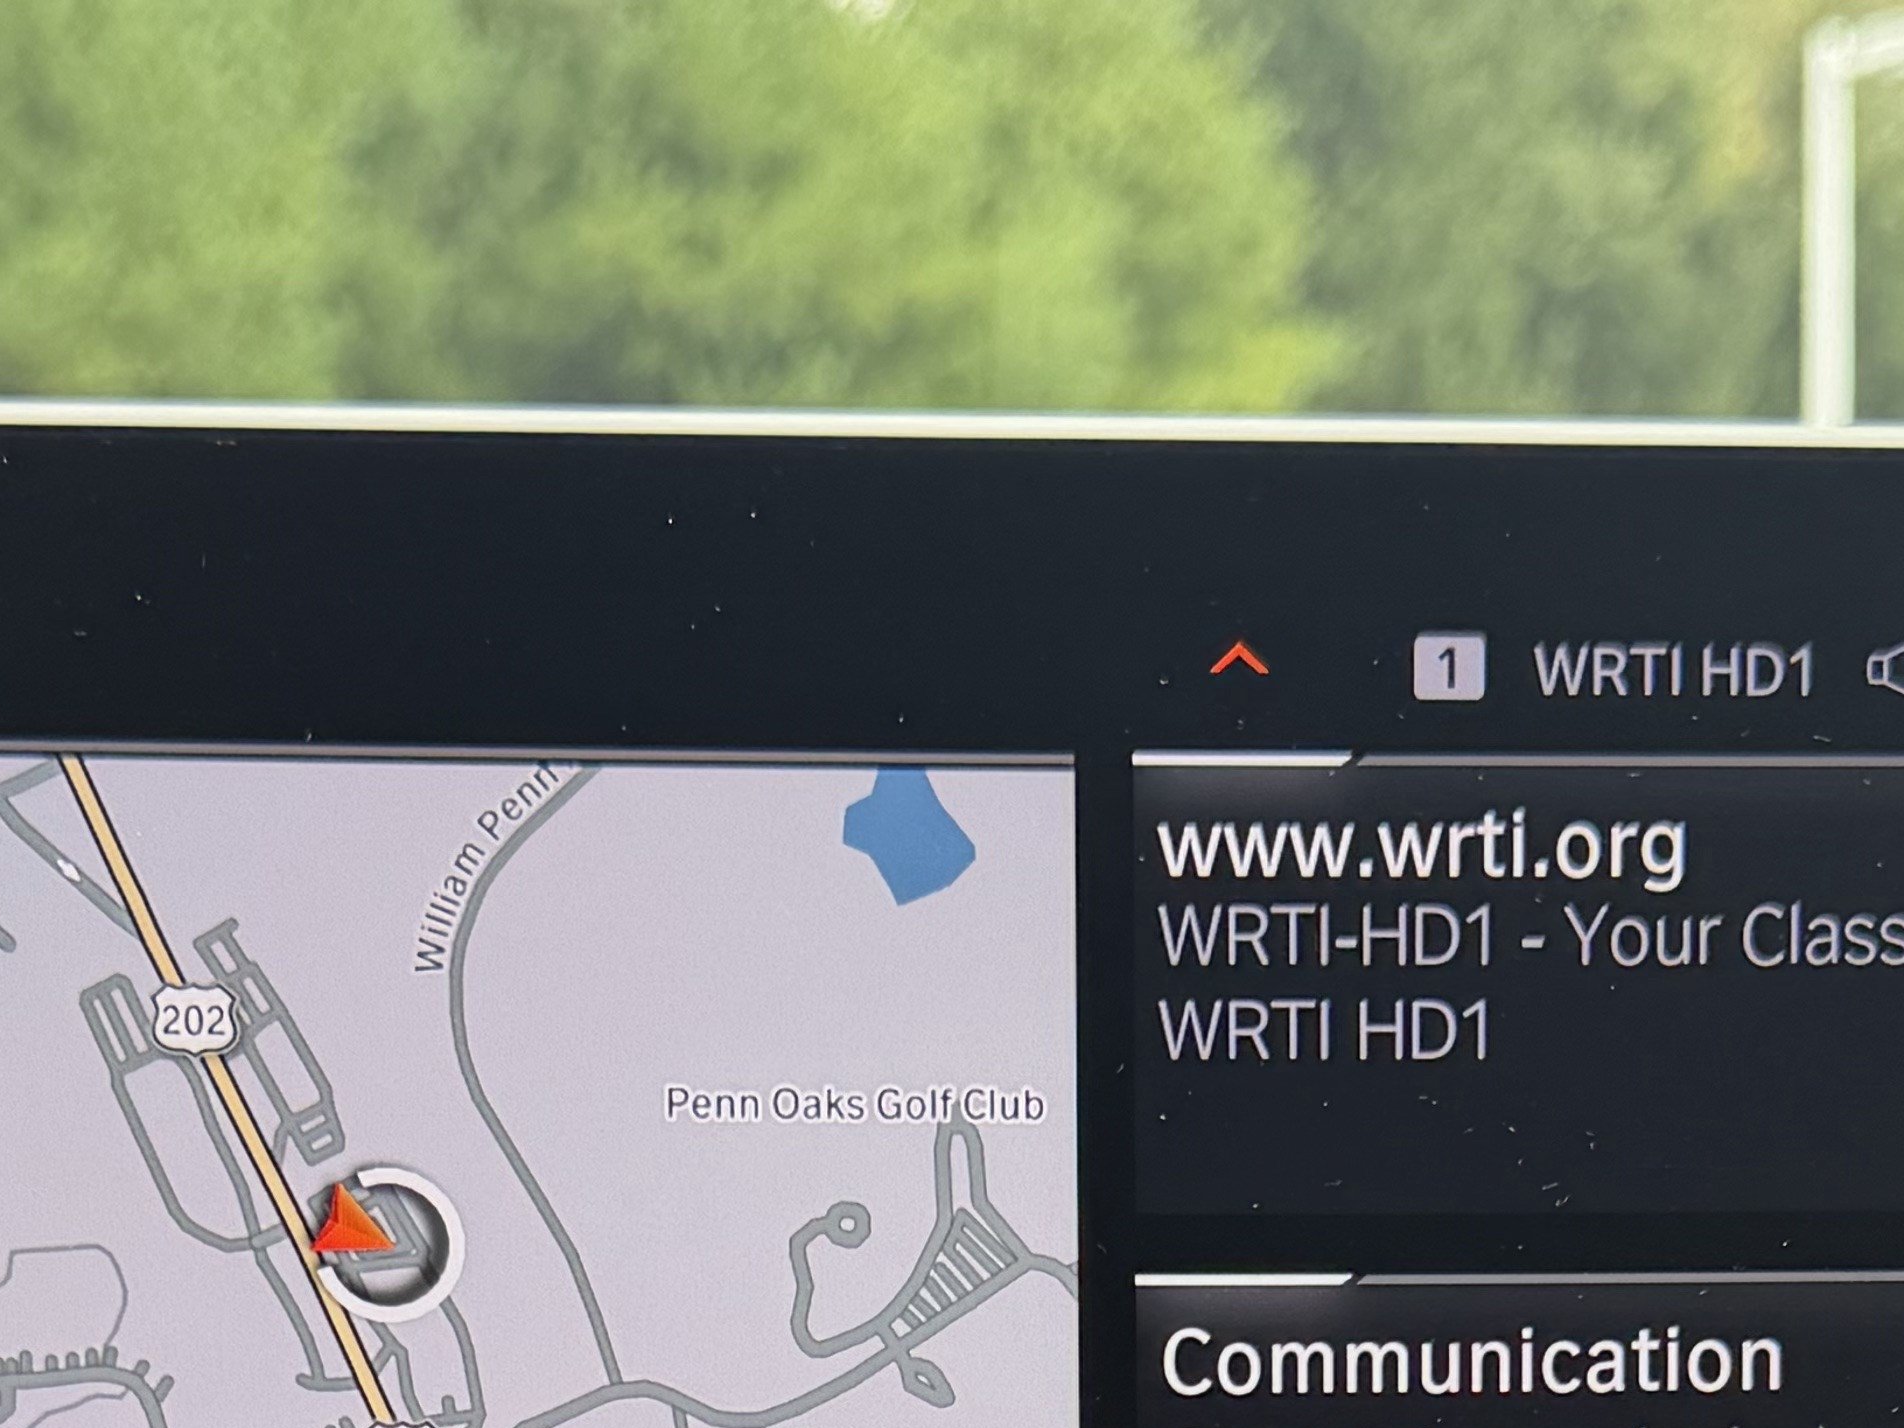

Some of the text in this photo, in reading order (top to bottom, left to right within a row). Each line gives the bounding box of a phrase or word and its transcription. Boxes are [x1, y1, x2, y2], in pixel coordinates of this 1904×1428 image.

[1435, 645, 1459, 690] 1
[1534, 640, 1684, 698] WRTI
[1701, 640, 1814, 698] HD1
[1156, 806, 1688, 892] www.wrti.org
[414, 842, 486, 972] William
[1156, 900, 1493, 968] WRTI-HD1
[1564, 900, 1724, 968] Your
[160, 1002, 228, 1039] 202
[1156, 998, 1490, 1062] WRTI HD1
[666, 1083, 1046, 1123] Penn Oaks Golf Club
[1161, 1324, 1784, 1397] Communication
